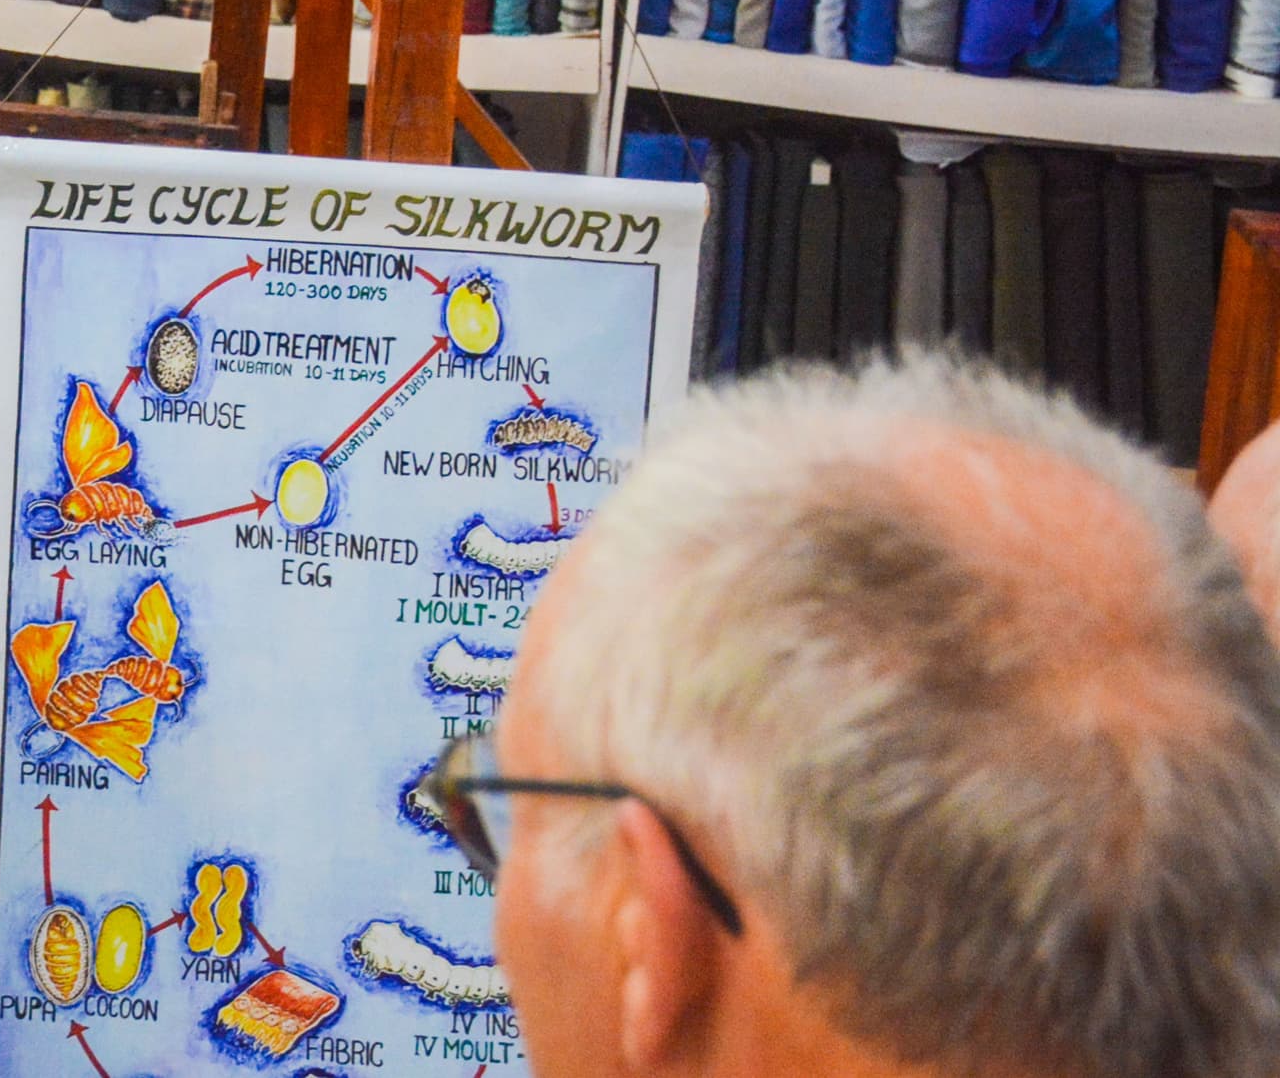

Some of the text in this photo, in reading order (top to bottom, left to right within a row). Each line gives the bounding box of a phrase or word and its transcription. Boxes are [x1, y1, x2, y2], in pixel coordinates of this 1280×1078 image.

[30, 180, 661, 255] LIFE CYCLE OF SILKWORM
[266, 247, 414, 282] HIBERNATION
[265, 281, 388, 302] 120-300 DAYS
[211, 329, 397, 366] ACID TREATMENT
[214, 358, 293, 378] INCUBATION
[349, 369, 387, 385] DAYS
[436, 353, 550, 385] HATCHING
[140, 396, 247, 430] DIAPAUSE
[326, 417, 383, 475] INCUBATION
[404, 366, 433, 396] DAYS
[383, 450, 434, 476] NEW
[440, 452, 497, 479] BORN
[29, 538, 167, 568] EGG LAYING
[235, 524, 419, 566] NON-HIBERNATED
[280, 559, 332, 587] EGG
[431, 572, 524, 602] I INSTAR
[396, 598, 409, 623] I
[20, 761, 109, 790] PAIRING
[433, 870, 453, 895] III
[181, 956, 241, 984] YARN
[0, 995, 159, 1022] PUPA COCOON
[450, 1011, 520, 1040] IV INS
[306, 1035, 385, 1068] FABRIC
[414, 1034, 438, 1057] IV
